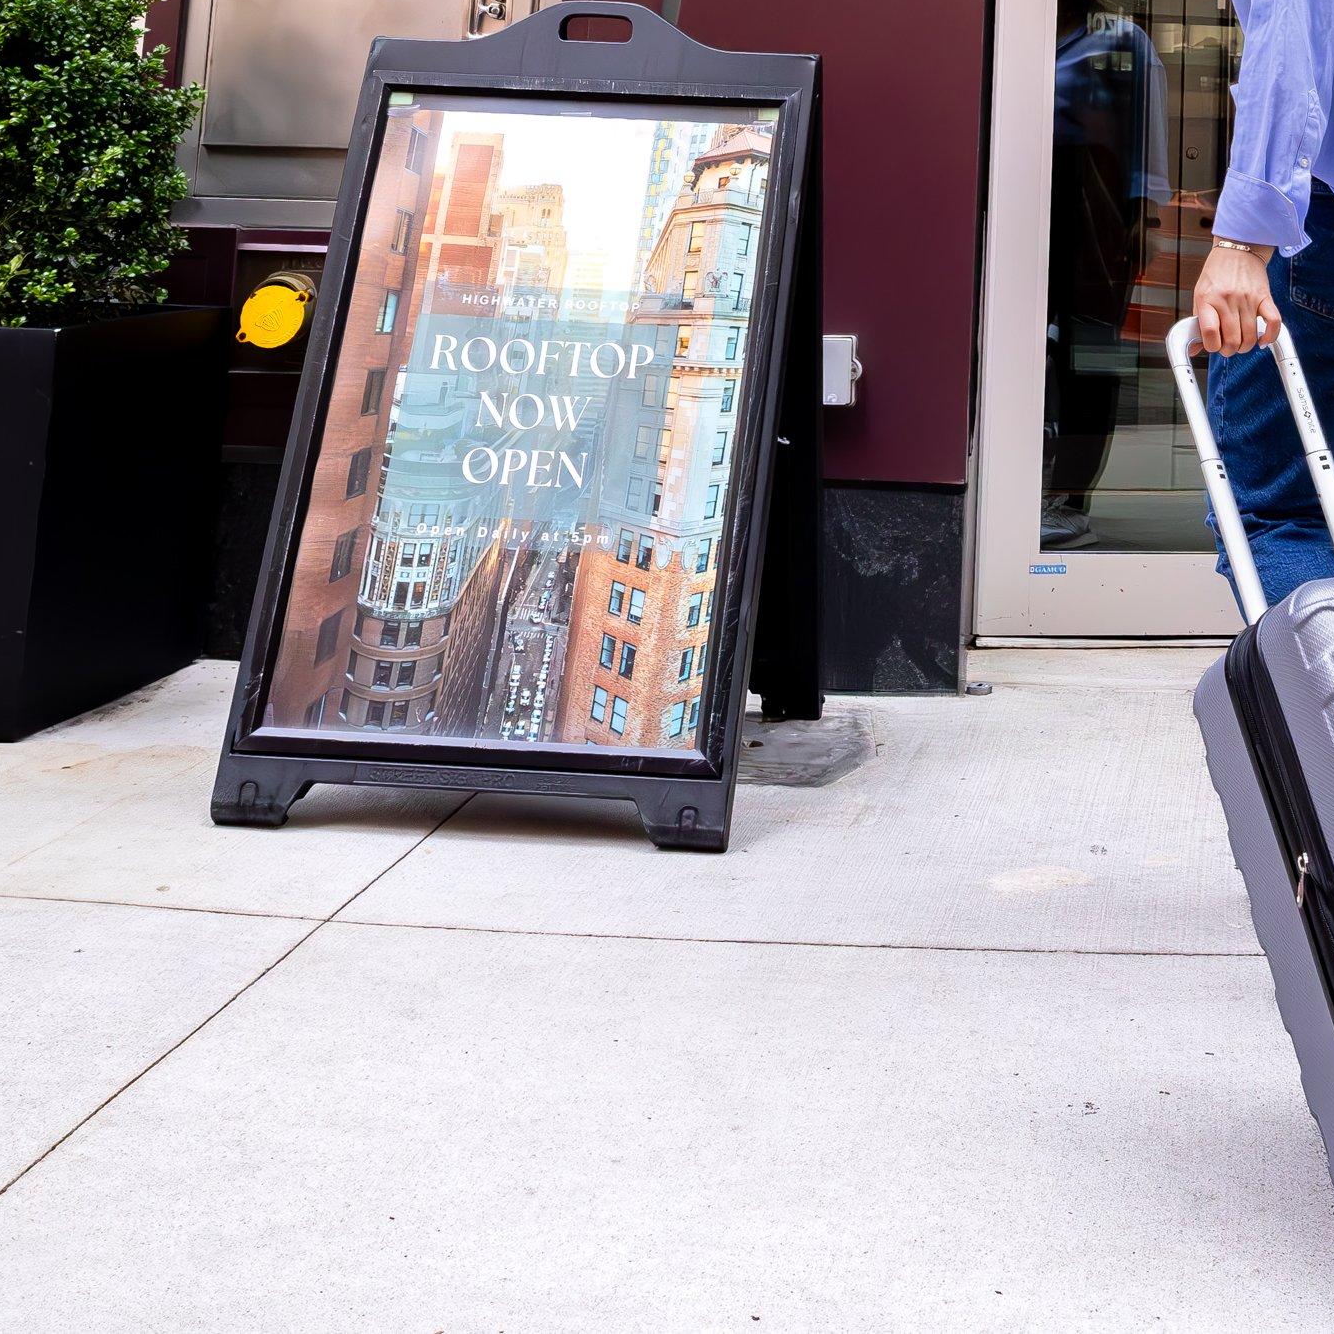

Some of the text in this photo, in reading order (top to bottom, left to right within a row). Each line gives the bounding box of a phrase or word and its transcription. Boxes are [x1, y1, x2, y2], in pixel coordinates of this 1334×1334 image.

[462, 294, 641, 313] HIGHWATER ROOFTOP
[429, 334, 655, 380] ROOFTOP
[475, 391, 593, 432] NOW
[1297, 387, 1316, 434] Samsonite
[462, 447, 588, 489] OPEN
[416, 522, 610, 546] Open Daily at 5pm
